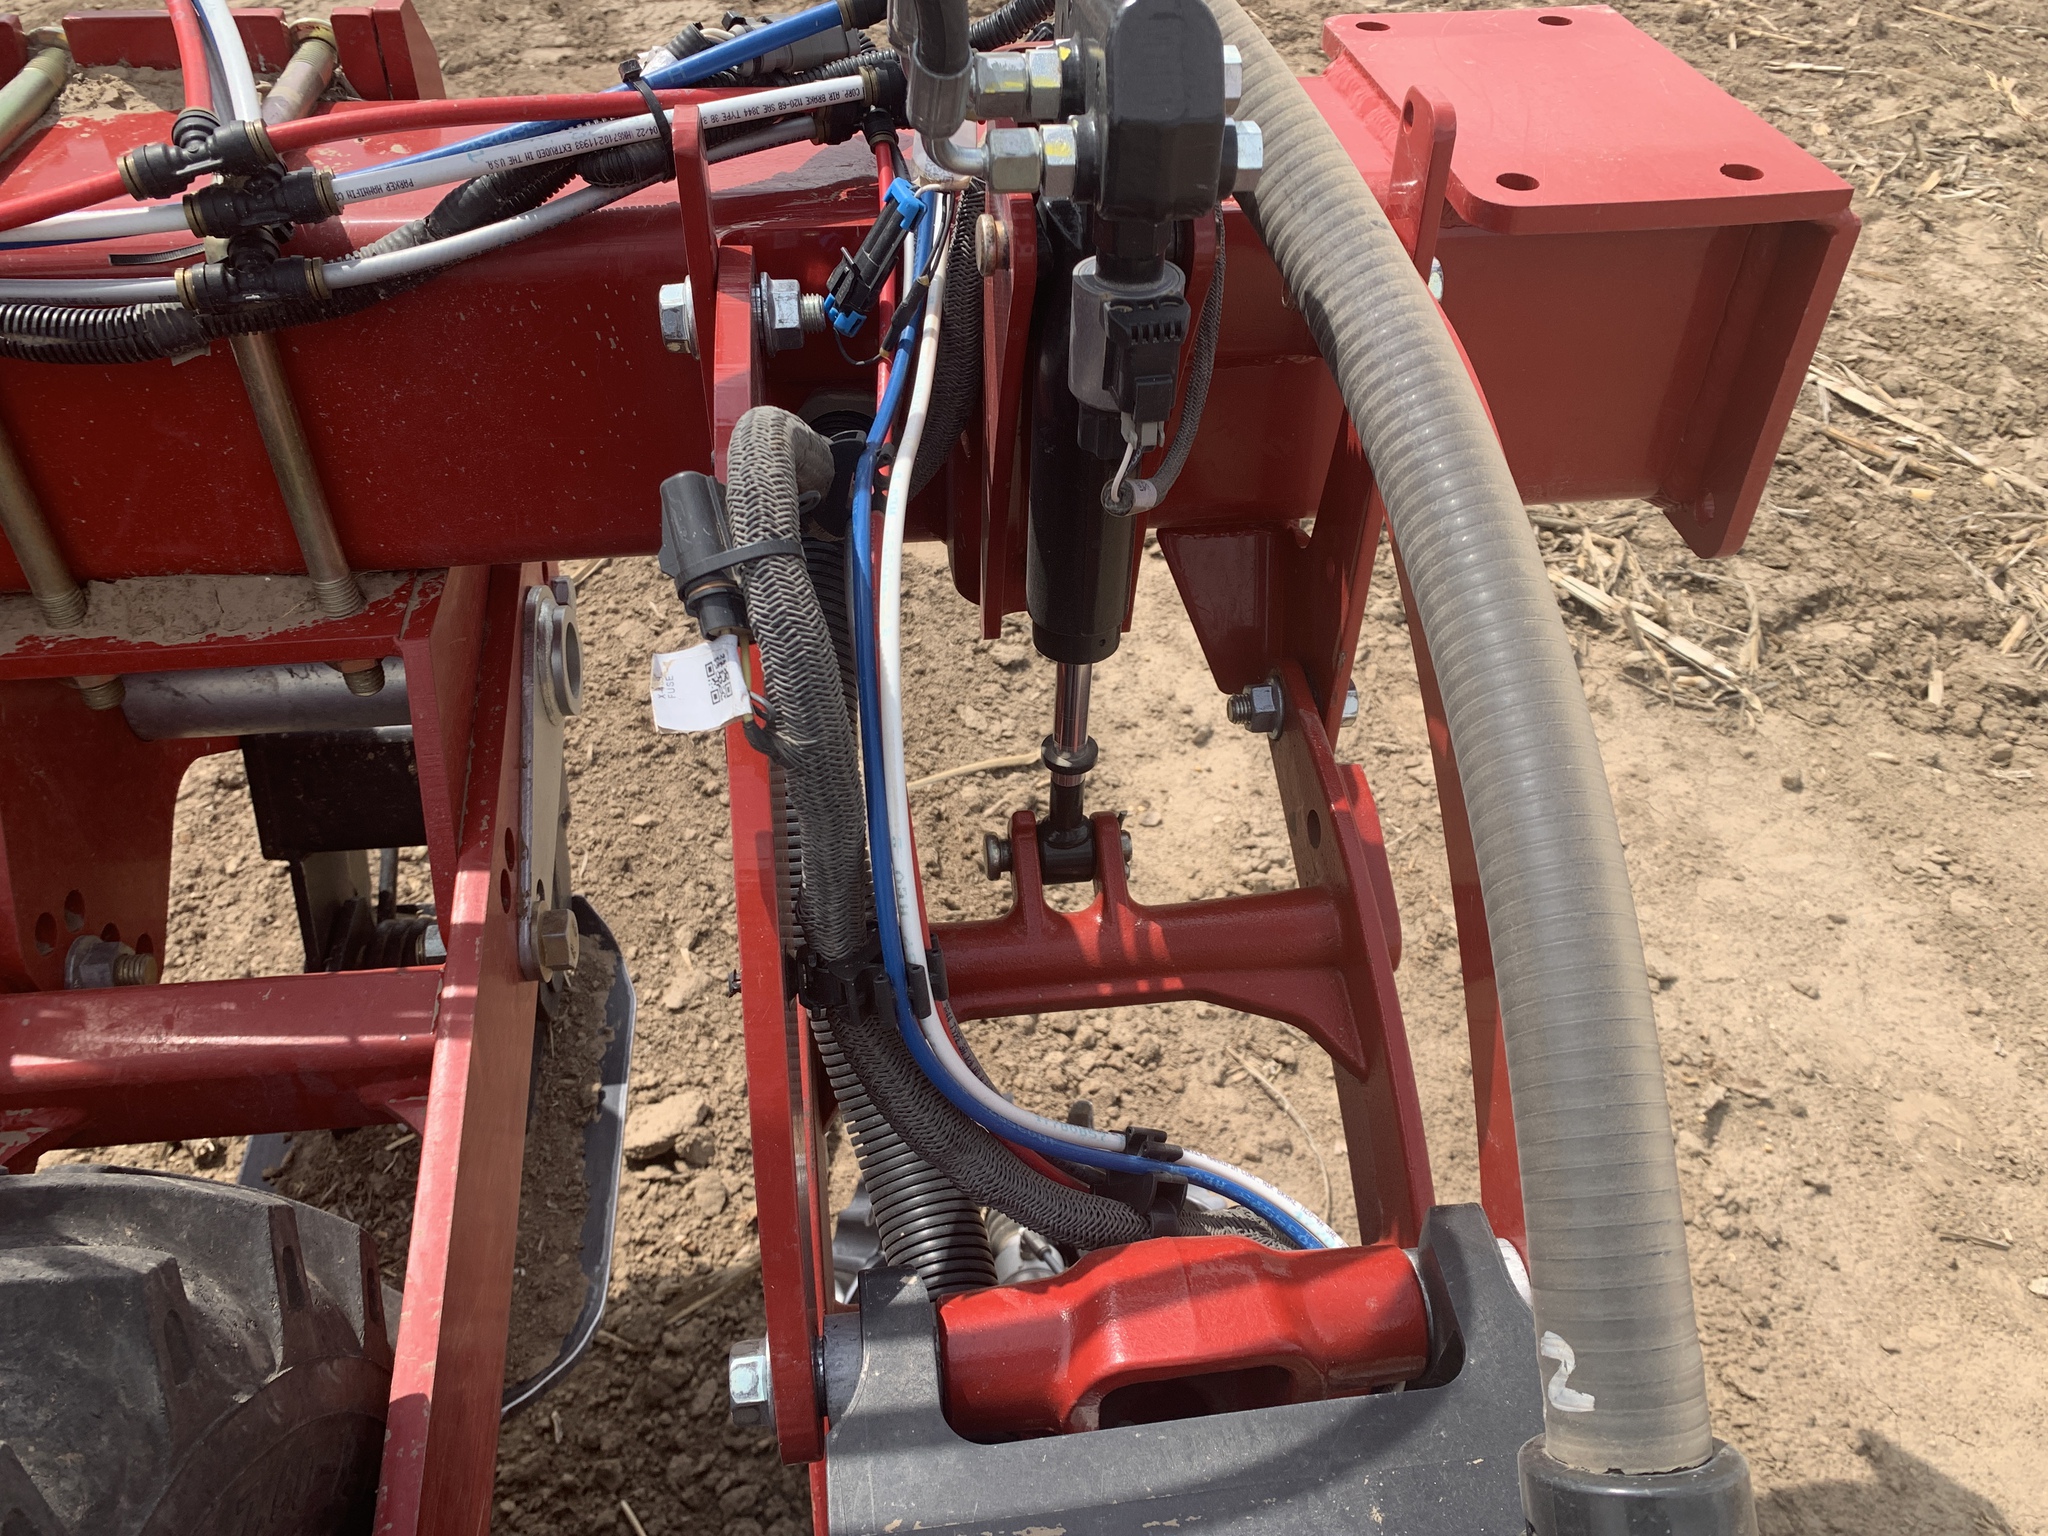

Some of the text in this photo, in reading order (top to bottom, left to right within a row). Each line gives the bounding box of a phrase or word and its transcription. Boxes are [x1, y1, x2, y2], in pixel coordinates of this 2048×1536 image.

[804, 93, 826, 105] BRAKE
[827, 90, 840, 101] AIR
[841, 87, 860, 99] CORP.
[743, 105, 760, 116] J844
[762, 102, 775, 113] SAE
[721, 109, 740, 121] TYPE
[523, 151, 533, 161] IN
[535, 142, 572, 158] EXTRUDED
[506, 153, 522, 165] THE
[383, 177, 414, 192] PARKER
[345, 183, 383, 199] HANNIFIN
[665, 675, 676, 699] FUSE
